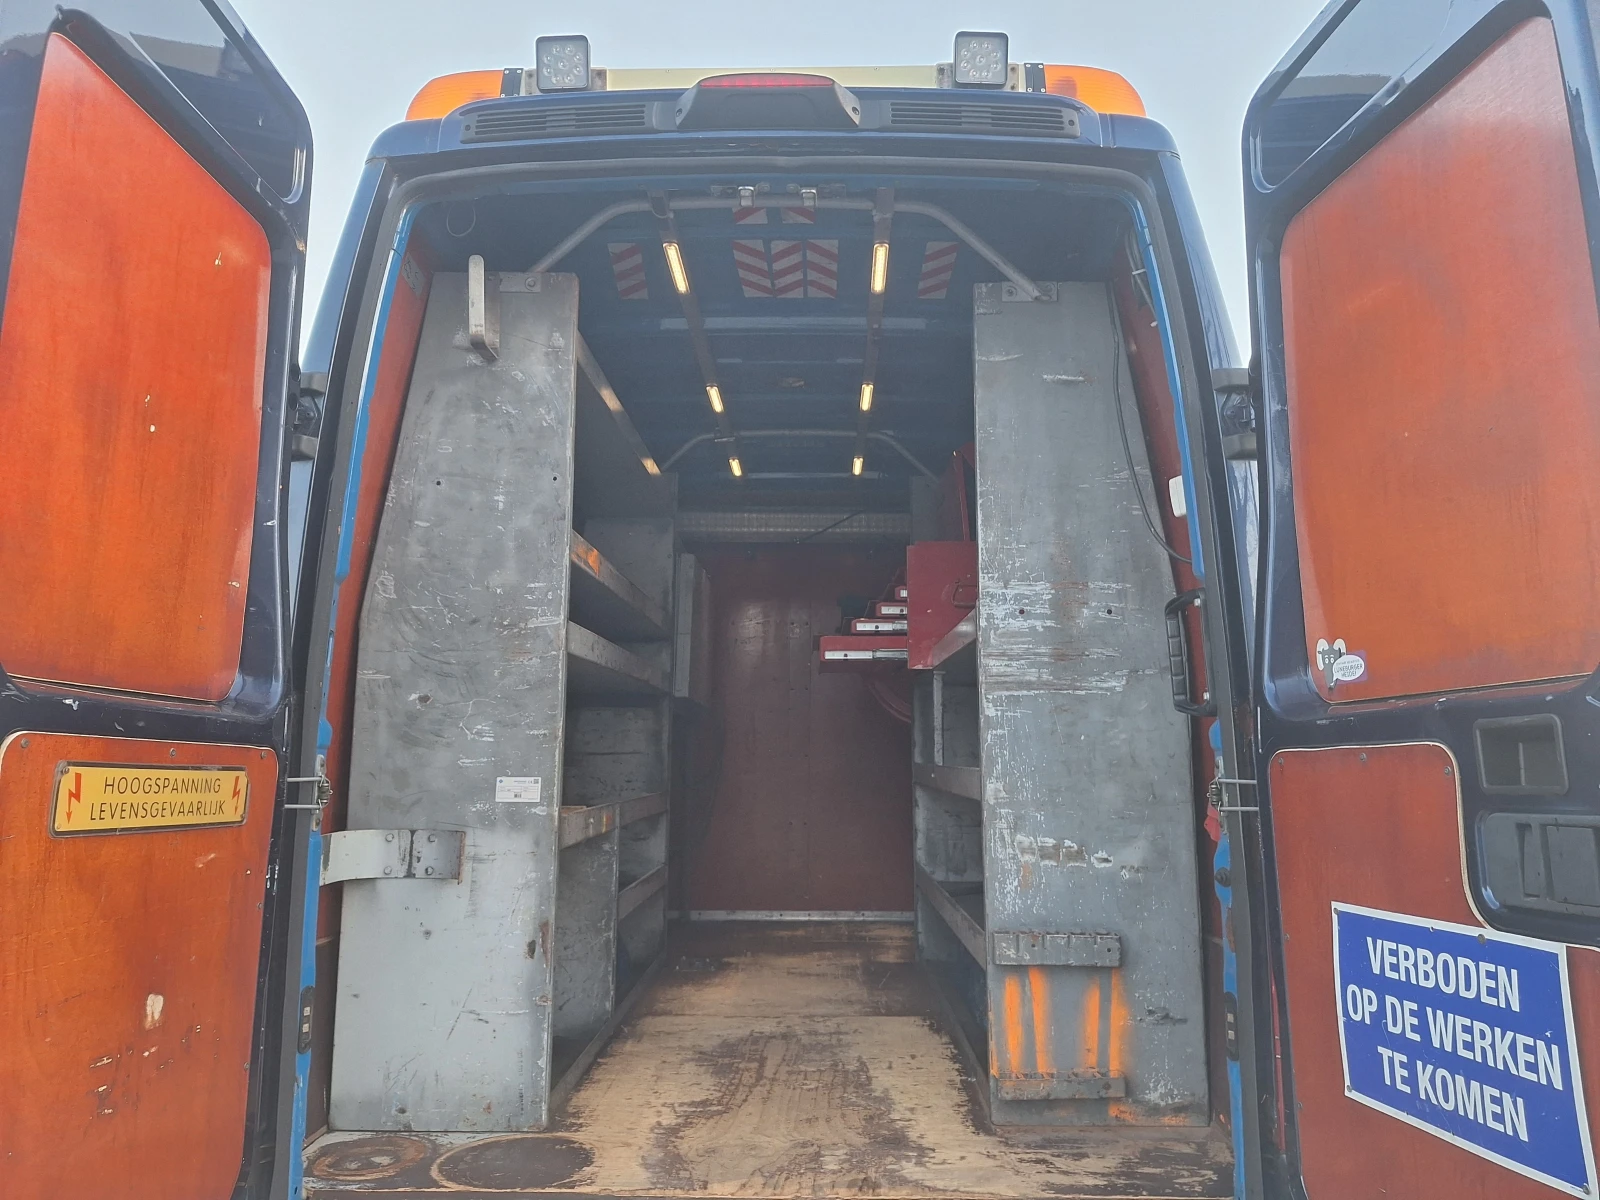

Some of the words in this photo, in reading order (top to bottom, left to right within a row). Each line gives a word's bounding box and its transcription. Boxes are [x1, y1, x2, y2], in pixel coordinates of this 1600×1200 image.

[90, 800, 226, 821] LEVENSGEVAARLIJK
[103, 776, 221, 794] HOOGSPANNING
[1366, 936, 1520, 1012] VERBODEN
[1346, 984, 1378, 1025] OP
[1385, 994, 1421, 1042] DE
[1426, 1006, 1563, 1090] WERKEN
[1377, 1046, 1412, 1094] TE
[1416, 1060, 1529, 1142] KOMEN
